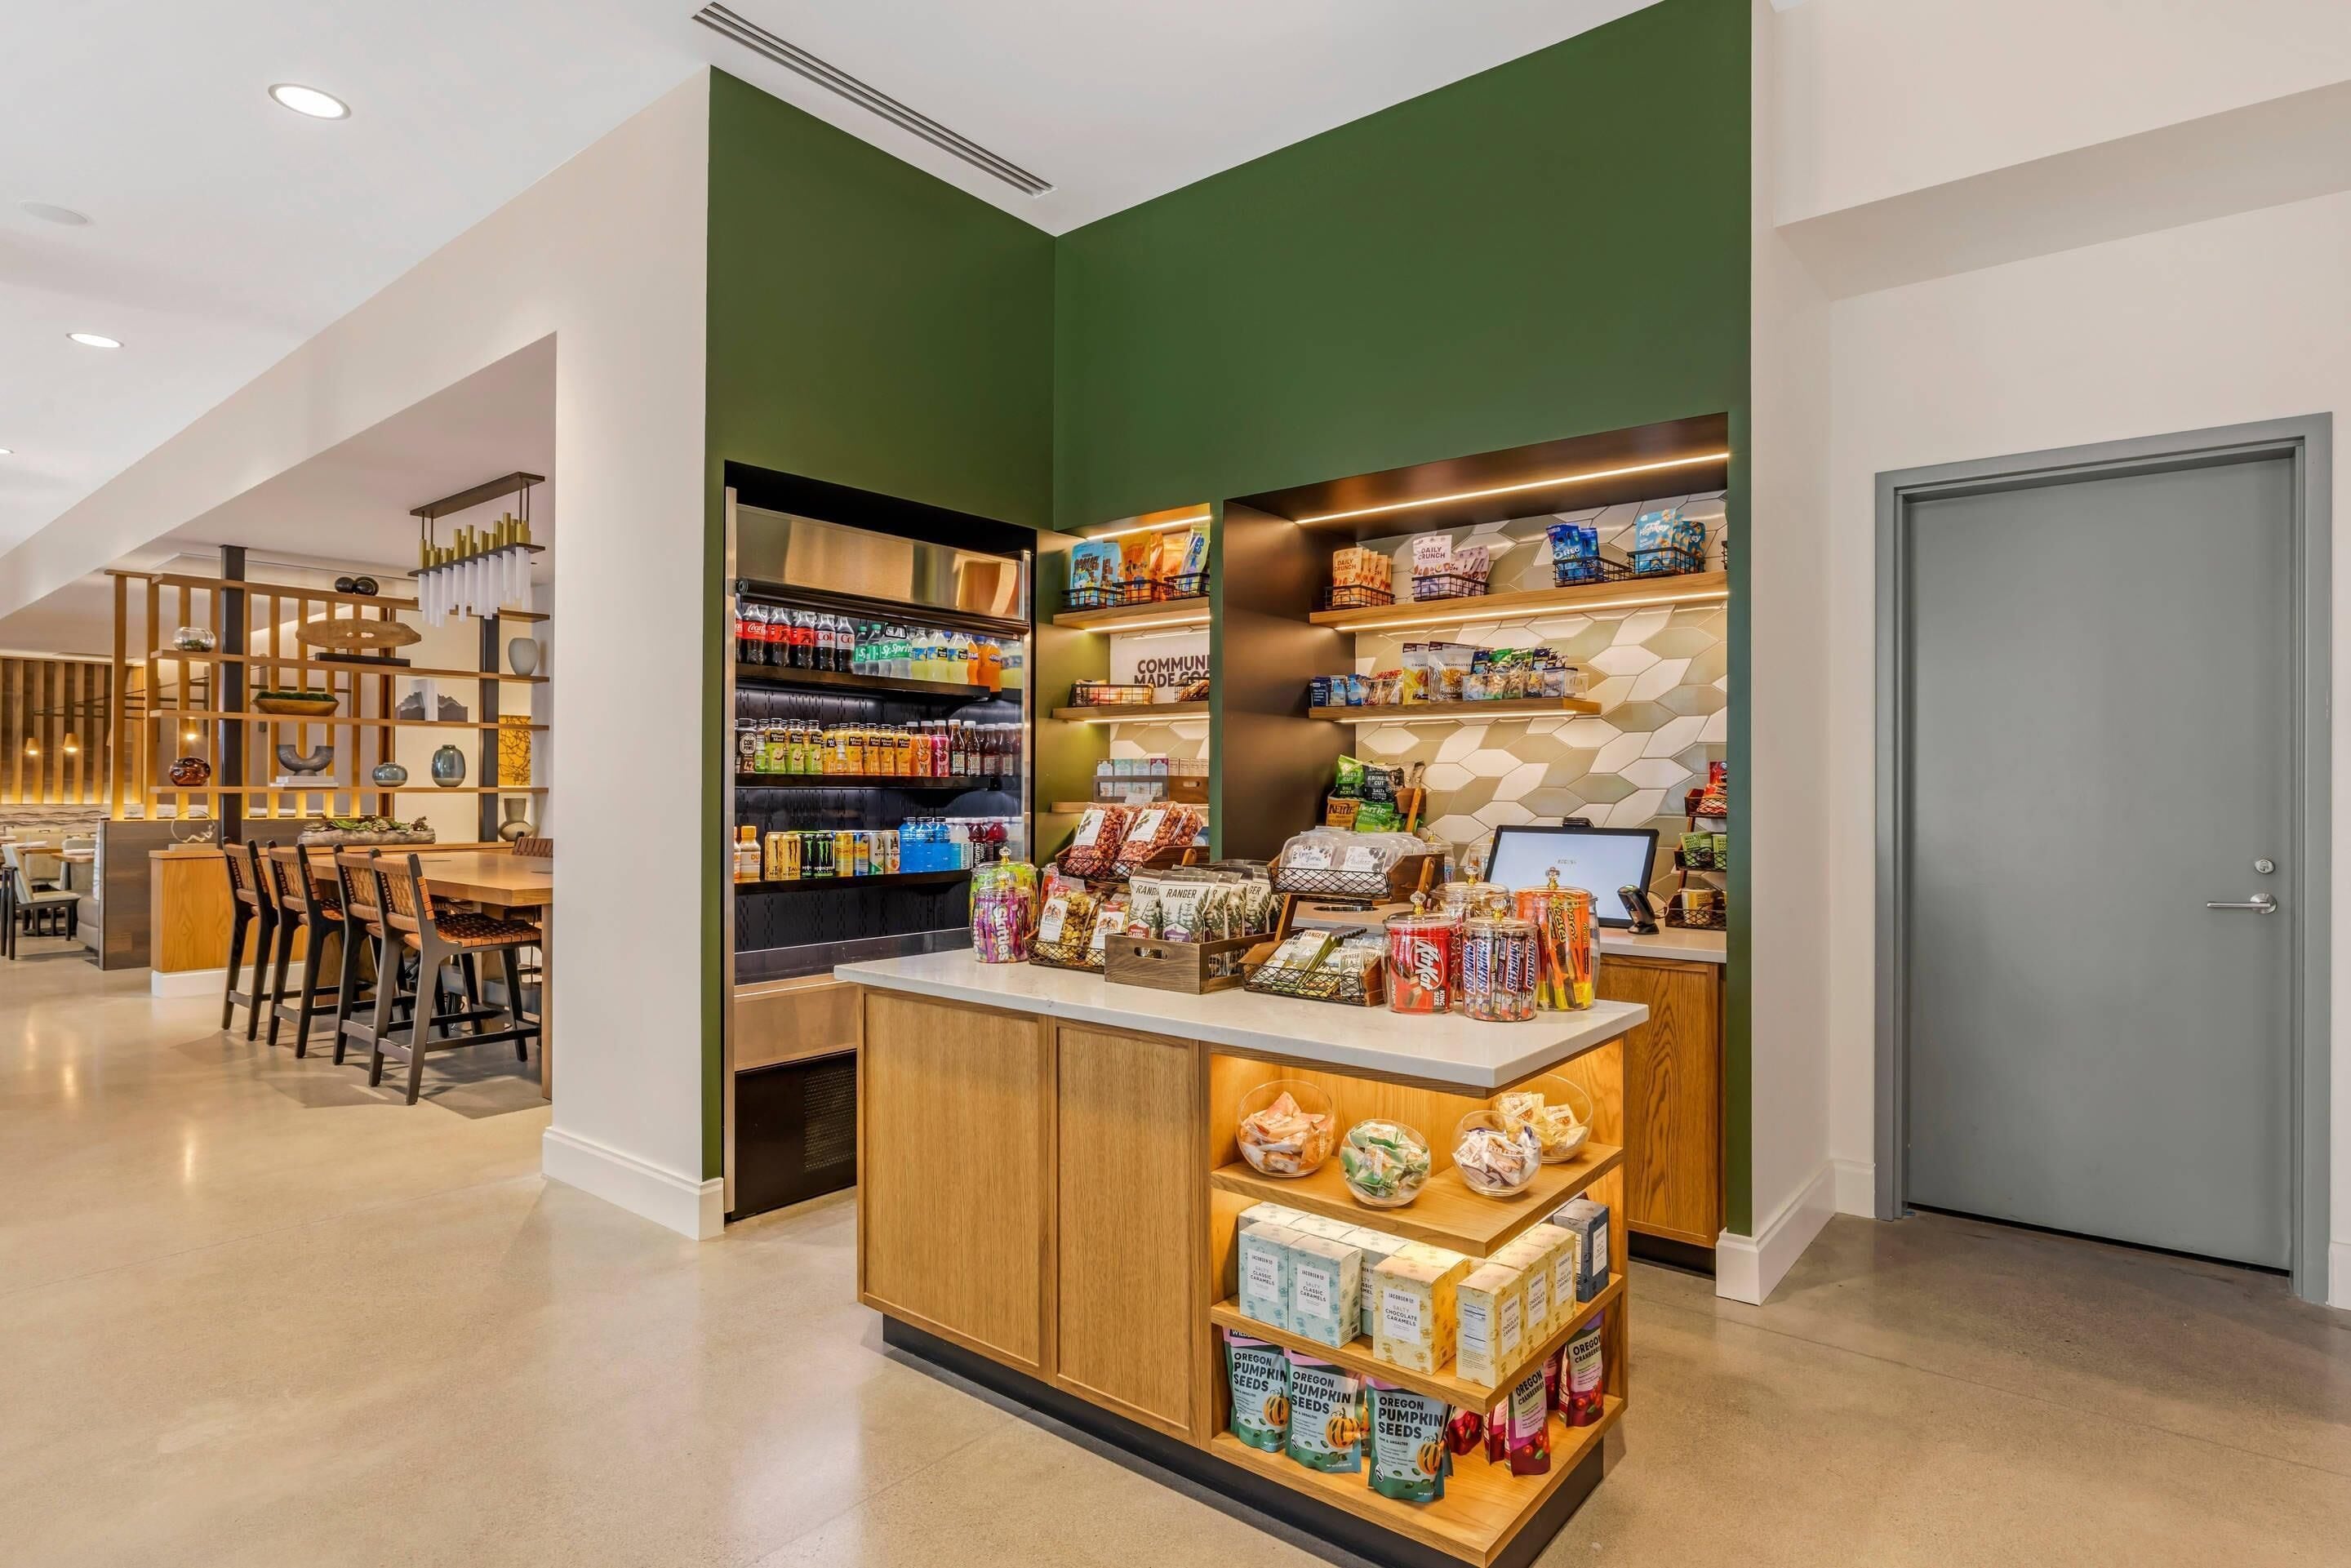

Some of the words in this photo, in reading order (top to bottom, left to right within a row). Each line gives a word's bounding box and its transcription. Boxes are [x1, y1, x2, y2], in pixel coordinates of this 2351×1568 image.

[1418, 553, 1446, 561] CRUNCH
[1554, 547, 1581, 558] OREO
[1335, 563, 1357, 571] CRUNCH
[1337, 558, 1353, 566] DAILY
[1134, 673, 1175, 688] MADE
[744, 761, 754, 771] 42
[1167, 888, 1197, 899] RANGER
[1305, 931, 1327, 939] RANGER
[1464, 943, 1475, 993] SNICKERS
[1478, 940, 1489, 993] SNICKERS
[1507, 942, 1520, 992] SNICKERS
[1250, 1275, 1274, 1286] CARAMELS
[1253, 1270, 1272, 1279] CLASSIC
[1300, 1290, 1326, 1302] CARAMELS
[1303, 1286, 1322, 1296] CLASSIC
[1389, 1293, 1409, 1303] JACOBSEN
[1384, 1308, 1418, 1321] CHOCOLATE
[1387, 1315, 1416, 1326] CARAMELS
[1572, 1334, 1601, 1356] OREGO
[1234, 1353, 1272, 1366] OREGON
[1233, 1362, 1287, 1383] PUMPKIN
[1233, 1374, 1269, 1392] SEEDS
[1293, 1371, 1335, 1388] OREGON
[1516, 1370, 1543, 1397] OREGON
[1292, 1382, 1351, 1404] PUMPKIN
[1518, 1381, 1544, 1406] CRANBERRIES
[1292, 1395, 1330, 1415] SEEDS
[1380, 1397, 1424, 1410] OREGON
[1379, 1407, 1443, 1427] PUMPKIN
[1378, 1421, 1422, 1439] SEEDS
